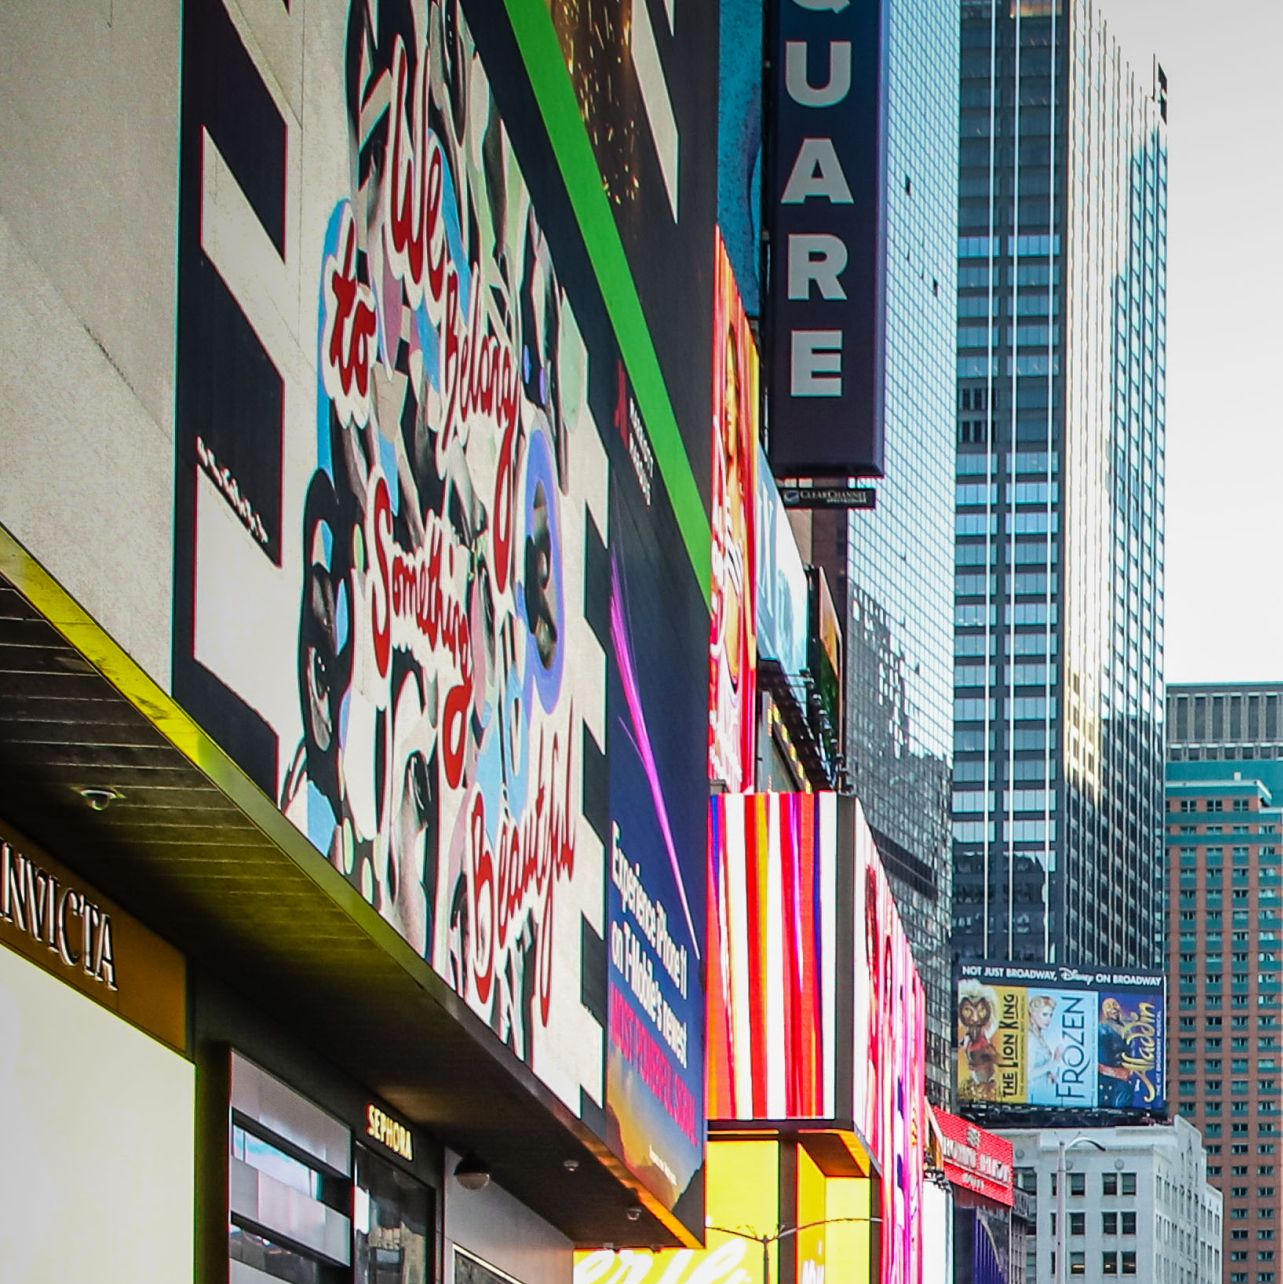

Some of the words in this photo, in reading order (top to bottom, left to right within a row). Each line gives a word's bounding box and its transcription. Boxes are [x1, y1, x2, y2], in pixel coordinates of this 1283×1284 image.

[388, 32, 443, 302] We
[781, 0, 854, 397] UARE
[331, 222, 376, 397] to
[372, 478, 472, 788] Something
[612, 820, 656, 949] Experience
[962, 966, 983, 976] NOT
[984, 967, 1004, 977] JUST
[1006, 968, 1057, 981] BROADWAY,
[1059, 967, 1093, 985] Disney
[1096, 974, 1111, 984] ON
[1113, 975, 1162, 986] BROADWAY
[1000, 994, 1019, 1029] KING
[1003, 1034, 1018, 1068] LION
[1003, 1072, 1014, 1098] THE
[1056, 996, 1090, 1099] FROZEN
[367, 1104, 413, 1161] SEPHORA
